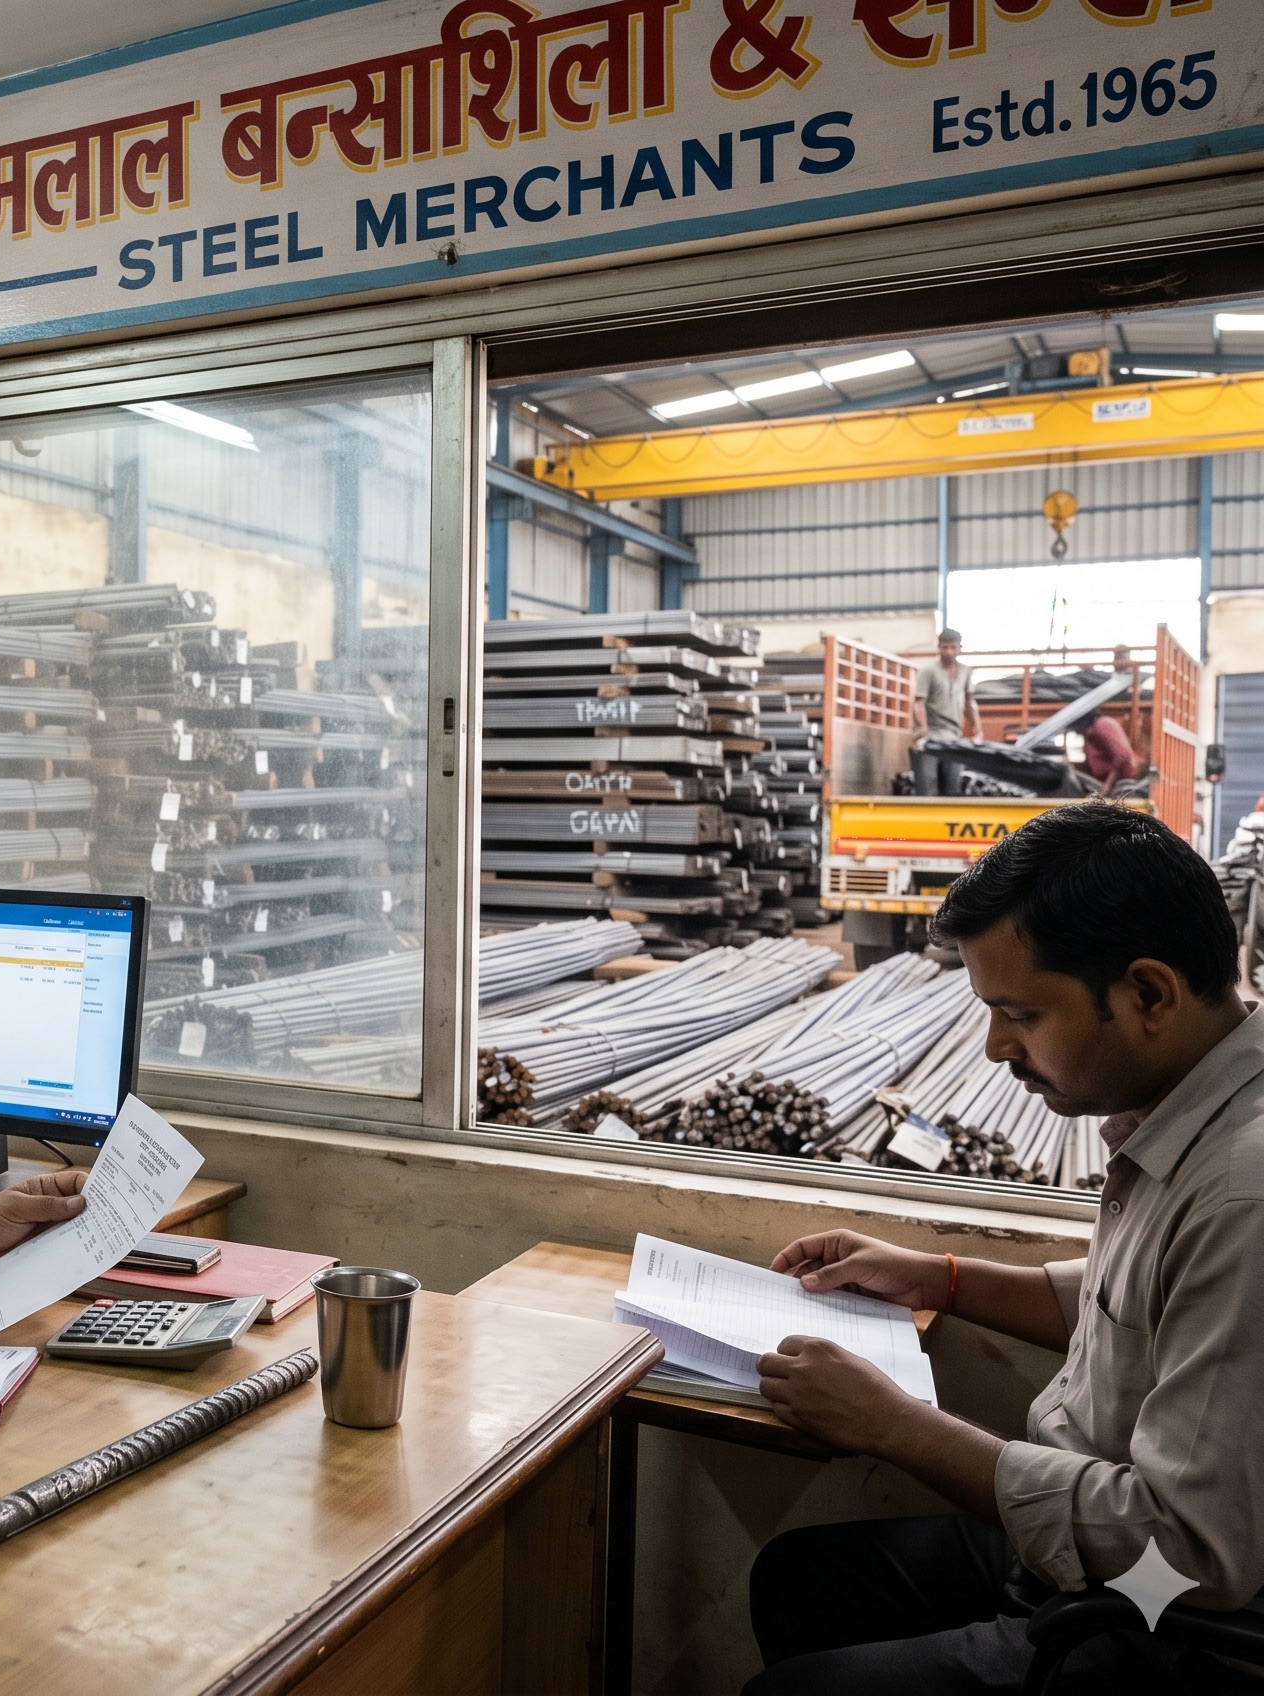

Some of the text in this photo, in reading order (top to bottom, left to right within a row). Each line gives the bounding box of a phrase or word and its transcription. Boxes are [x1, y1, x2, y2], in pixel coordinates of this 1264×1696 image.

[710, 0, 821, 98] &
[118, 111, 856, 290] STEEL MERCHANTS
[945, 823, 1008, 838] TATA
